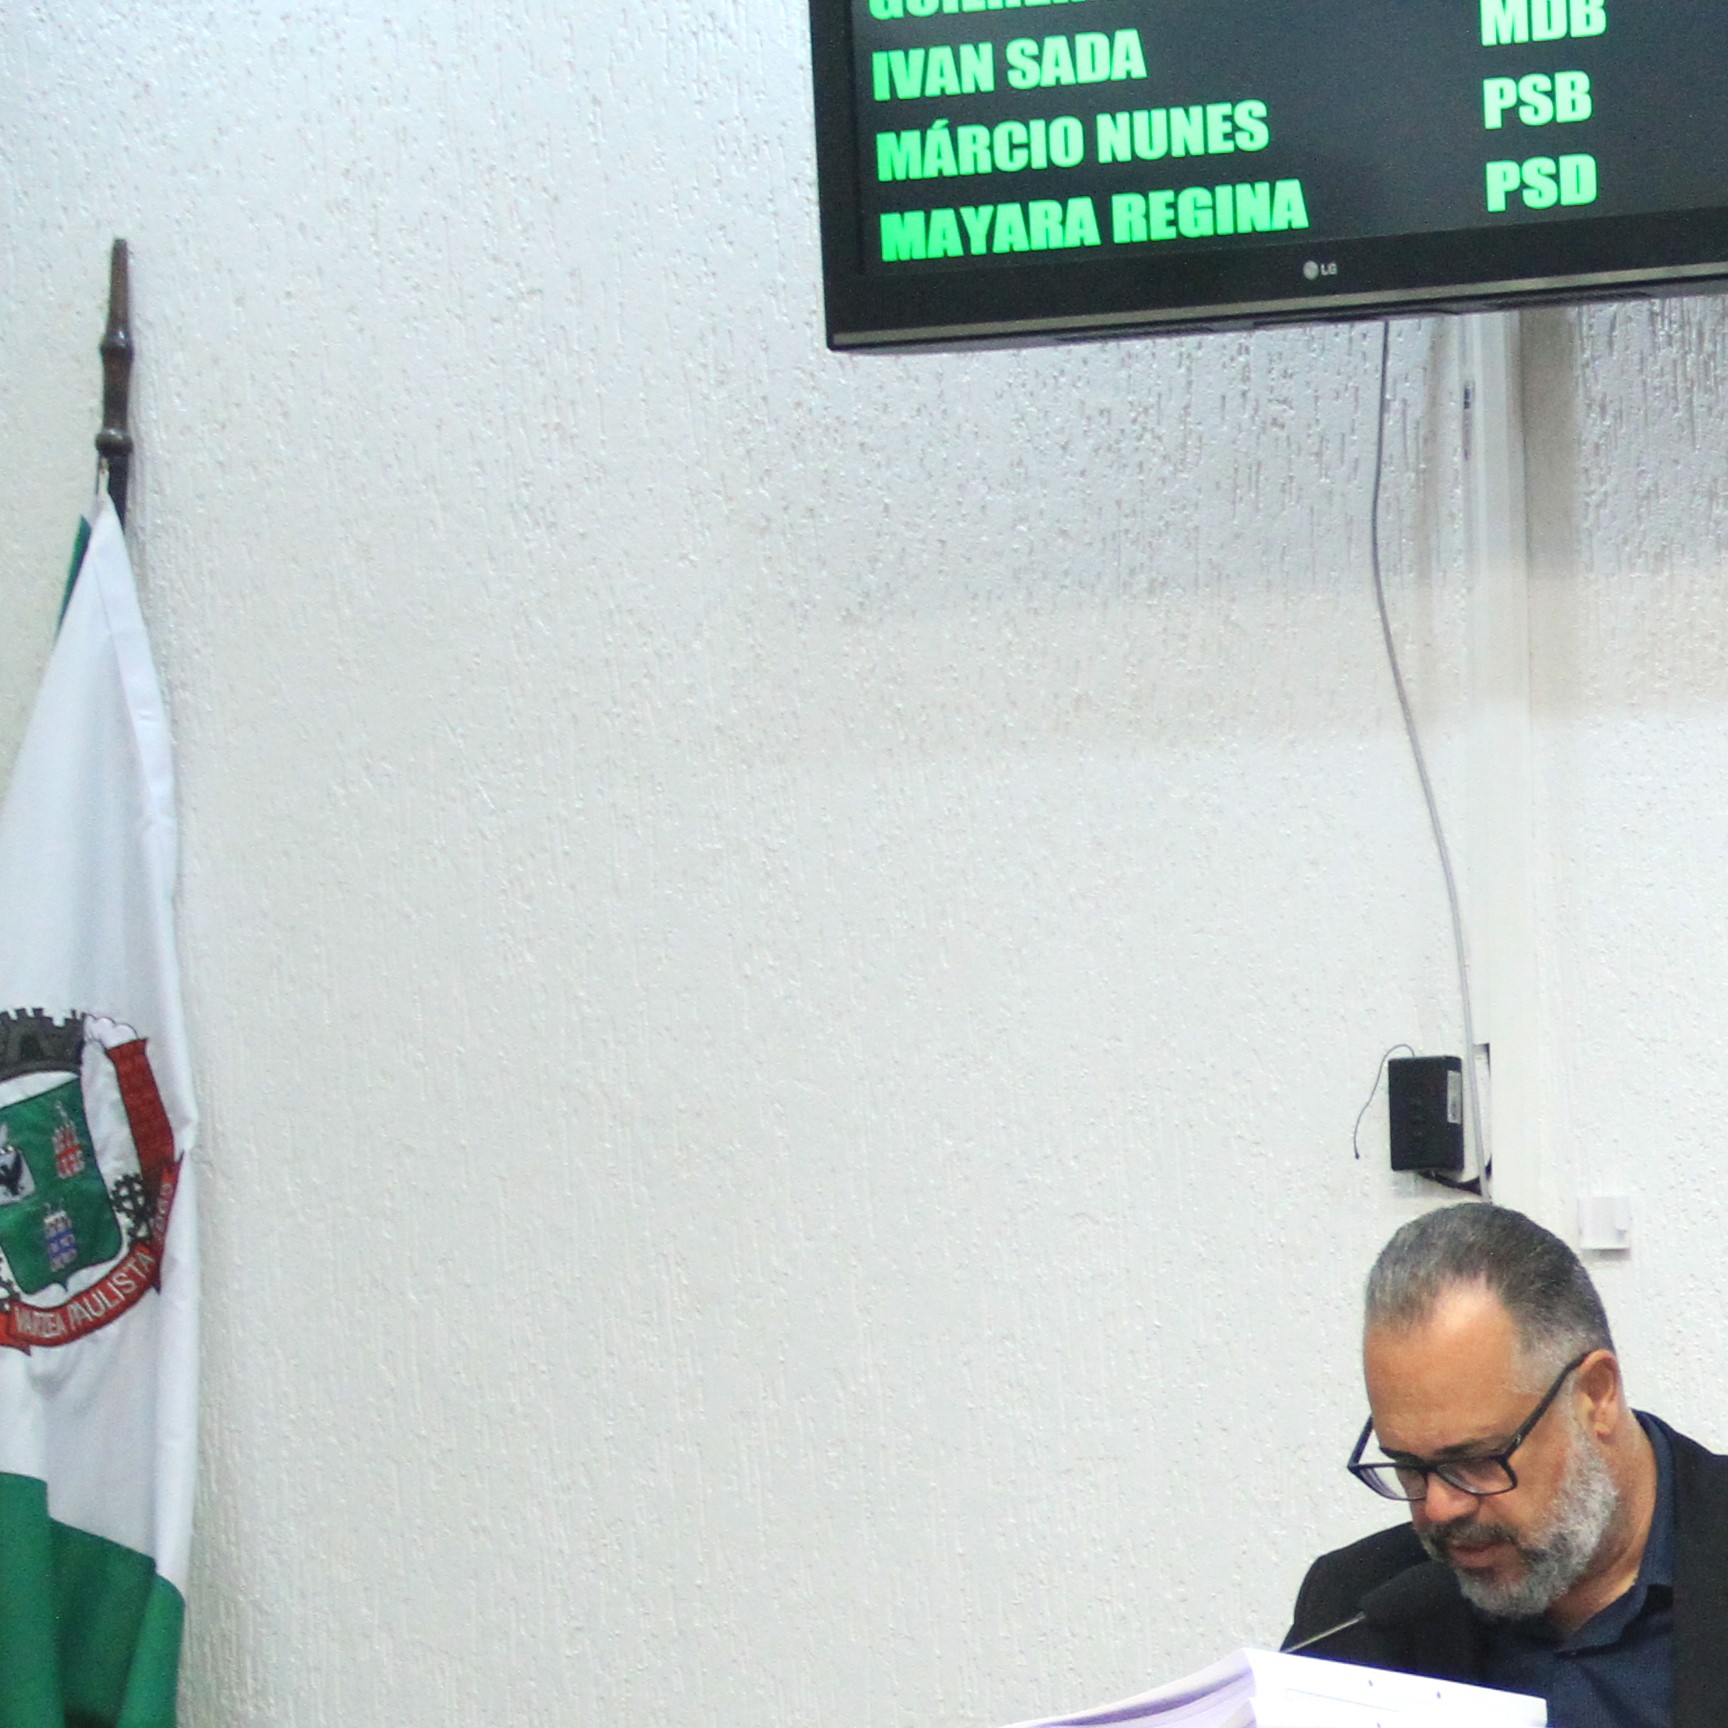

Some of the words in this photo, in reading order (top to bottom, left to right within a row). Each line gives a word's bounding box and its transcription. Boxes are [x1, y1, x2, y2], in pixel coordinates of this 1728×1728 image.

[1480, 0, 1607, 46] MDB
[871, 42, 995, 101] IVAN
[1005, 28, 1148, 90] SADA
[1483, 70, 1593, 129] PSB
[875, 116, 1085, 182] MÁRCIO
[1096, 99, 1270, 163] NUNES
[1486, 153, 1598, 212] PSD
[880, 196, 1101, 262] MAYARA
[1111, 178, 1309, 244] REGINA
[1320, 263, 1338, 276] LG
[67, 1251, 155, 1331] PAULISTA
